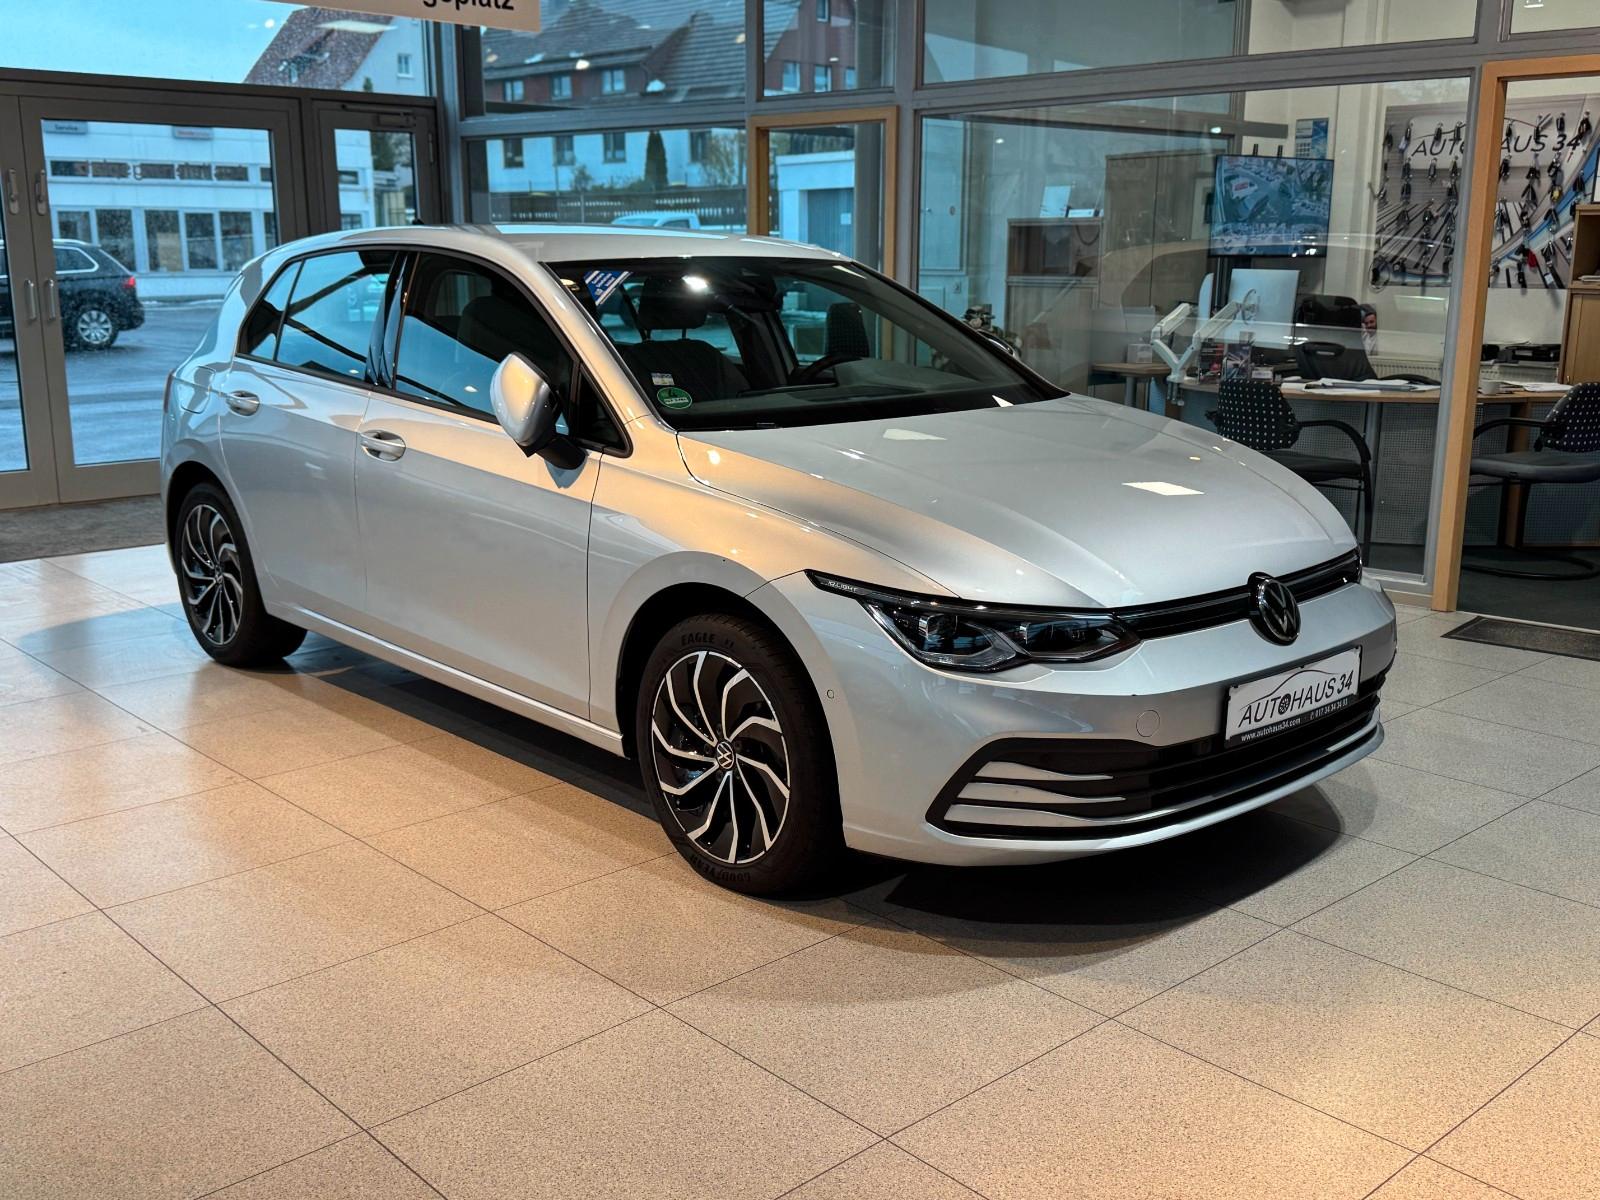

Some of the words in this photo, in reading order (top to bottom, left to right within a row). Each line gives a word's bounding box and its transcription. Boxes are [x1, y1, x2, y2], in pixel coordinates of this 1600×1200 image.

[1552, 132, 1580, 151] 34
[681, 632, 715, 647] EAGLE
[1238, 678, 1337, 728] AUTOHAUS
[1337, 670, 1354, 694] 34
